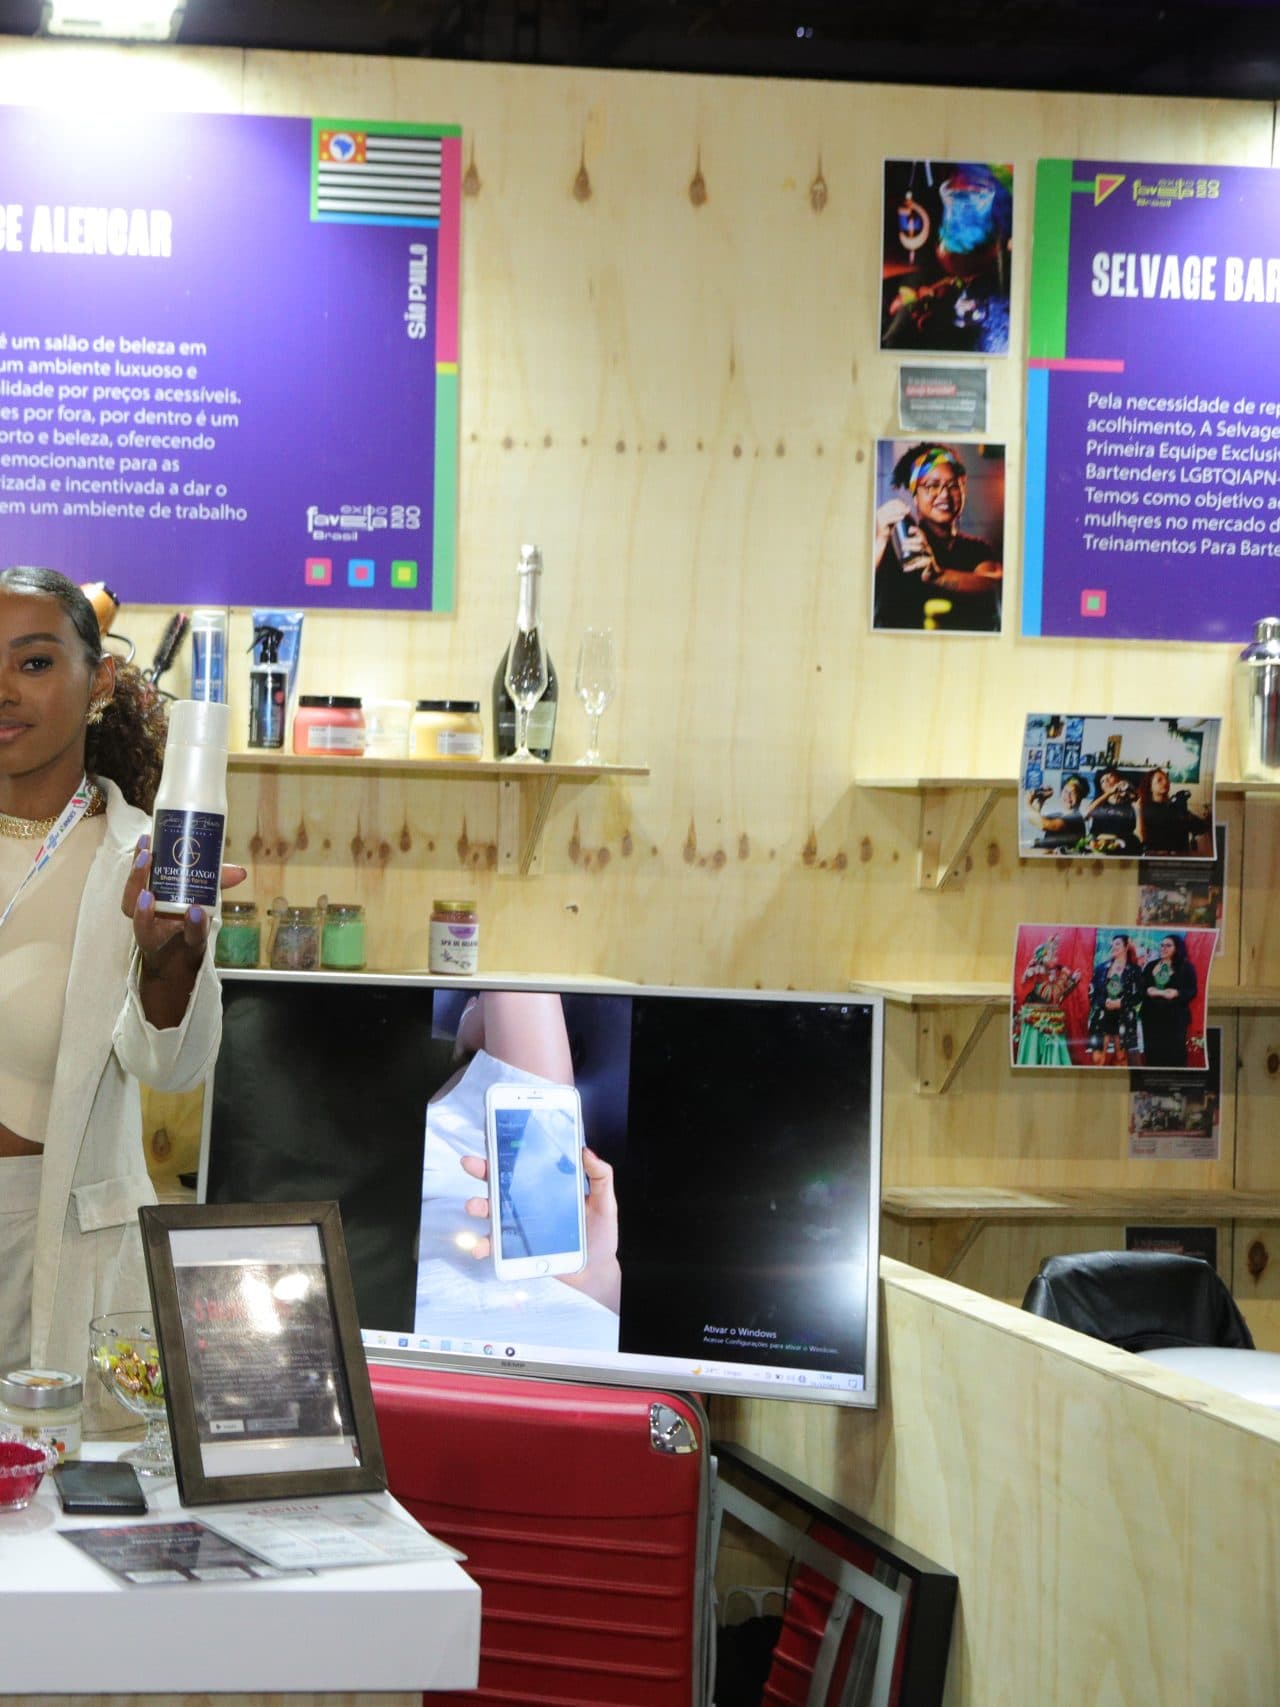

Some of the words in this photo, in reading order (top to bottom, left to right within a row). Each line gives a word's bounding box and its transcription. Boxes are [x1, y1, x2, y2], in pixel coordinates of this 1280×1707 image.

[31, 203, 171, 256] ALENCAR
[1092, 252, 1215, 300] SELVAGE
[12, 337, 39, 351] um
[45, 333, 88, 352] salão
[93, 335, 115, 353] de
[119, 335, 174, 355] beleza
[179, 342, 206, 356] em
[28, 356, 110, 377] ambiente
[115, 359, 182, 379] luxuoso
[187, 366, 196, 380] e
[59, 386, 88, 404] por
[93, 387, 149, 406] preços
[155, 384, 240, 404] acessíveis.
[1088, 392, 1121, 408] Pela
[1127, 395, 1228, 412] necessidade
[1234, 397, 1254, 413] de
[24, 408, 54, 426] por
[58, 404, 94, 425] fora,
[100, 410, 129, 428] por
[134, 406, 191, 426] dentro
[196, 408, 206, 426] é
[211, 413, 238, 427] um
[1087, 416, 1194, 437] acolhimento,
[1200, 420, 1211, 435] A
[38, 432, 48, 445] e
[54, 427, 112, 449] beleza,
[117, 429, 214, 450] oferecendo
[1087, 439, 1153, 457] Primeira
[1160, 442, 1216, 462] Equipe
[1, 449, 114, 470] emocionante
[120, 458, 156, 476] para
[162, 459, 179, 472] as
[1086, 463, 1175, 481] Bartenders
[51, 479, 60, 492] e
[66, 475, 164, 495] incentivada
[169, 483, 178, 496] a
[183, 478, 211, 497] dar
[216, 484, 228, 497] o
[31, 502, 57, 516] um
[63, 498, 144, 518] ambiente
[149, 501, 170, 519] de
[176, 501, 246, 521] trabalho
[1085, 486, 1138, 503] Temos
[1143, 492, 1190, 506] como
[1195, 491, 1263, 510] objetivo
[1085, 510, 1160, 529] mulheres
[1166, 517, 1187, 529] no
[1193, 516, 1264, 531] mercado
[1083, 534, 1195, 553] Treinamentos
[1201, 538, 1234, 554] Para
[704, 1325, 728, 1334] Ativar
[738, 1327, 777, 1339] Windows
